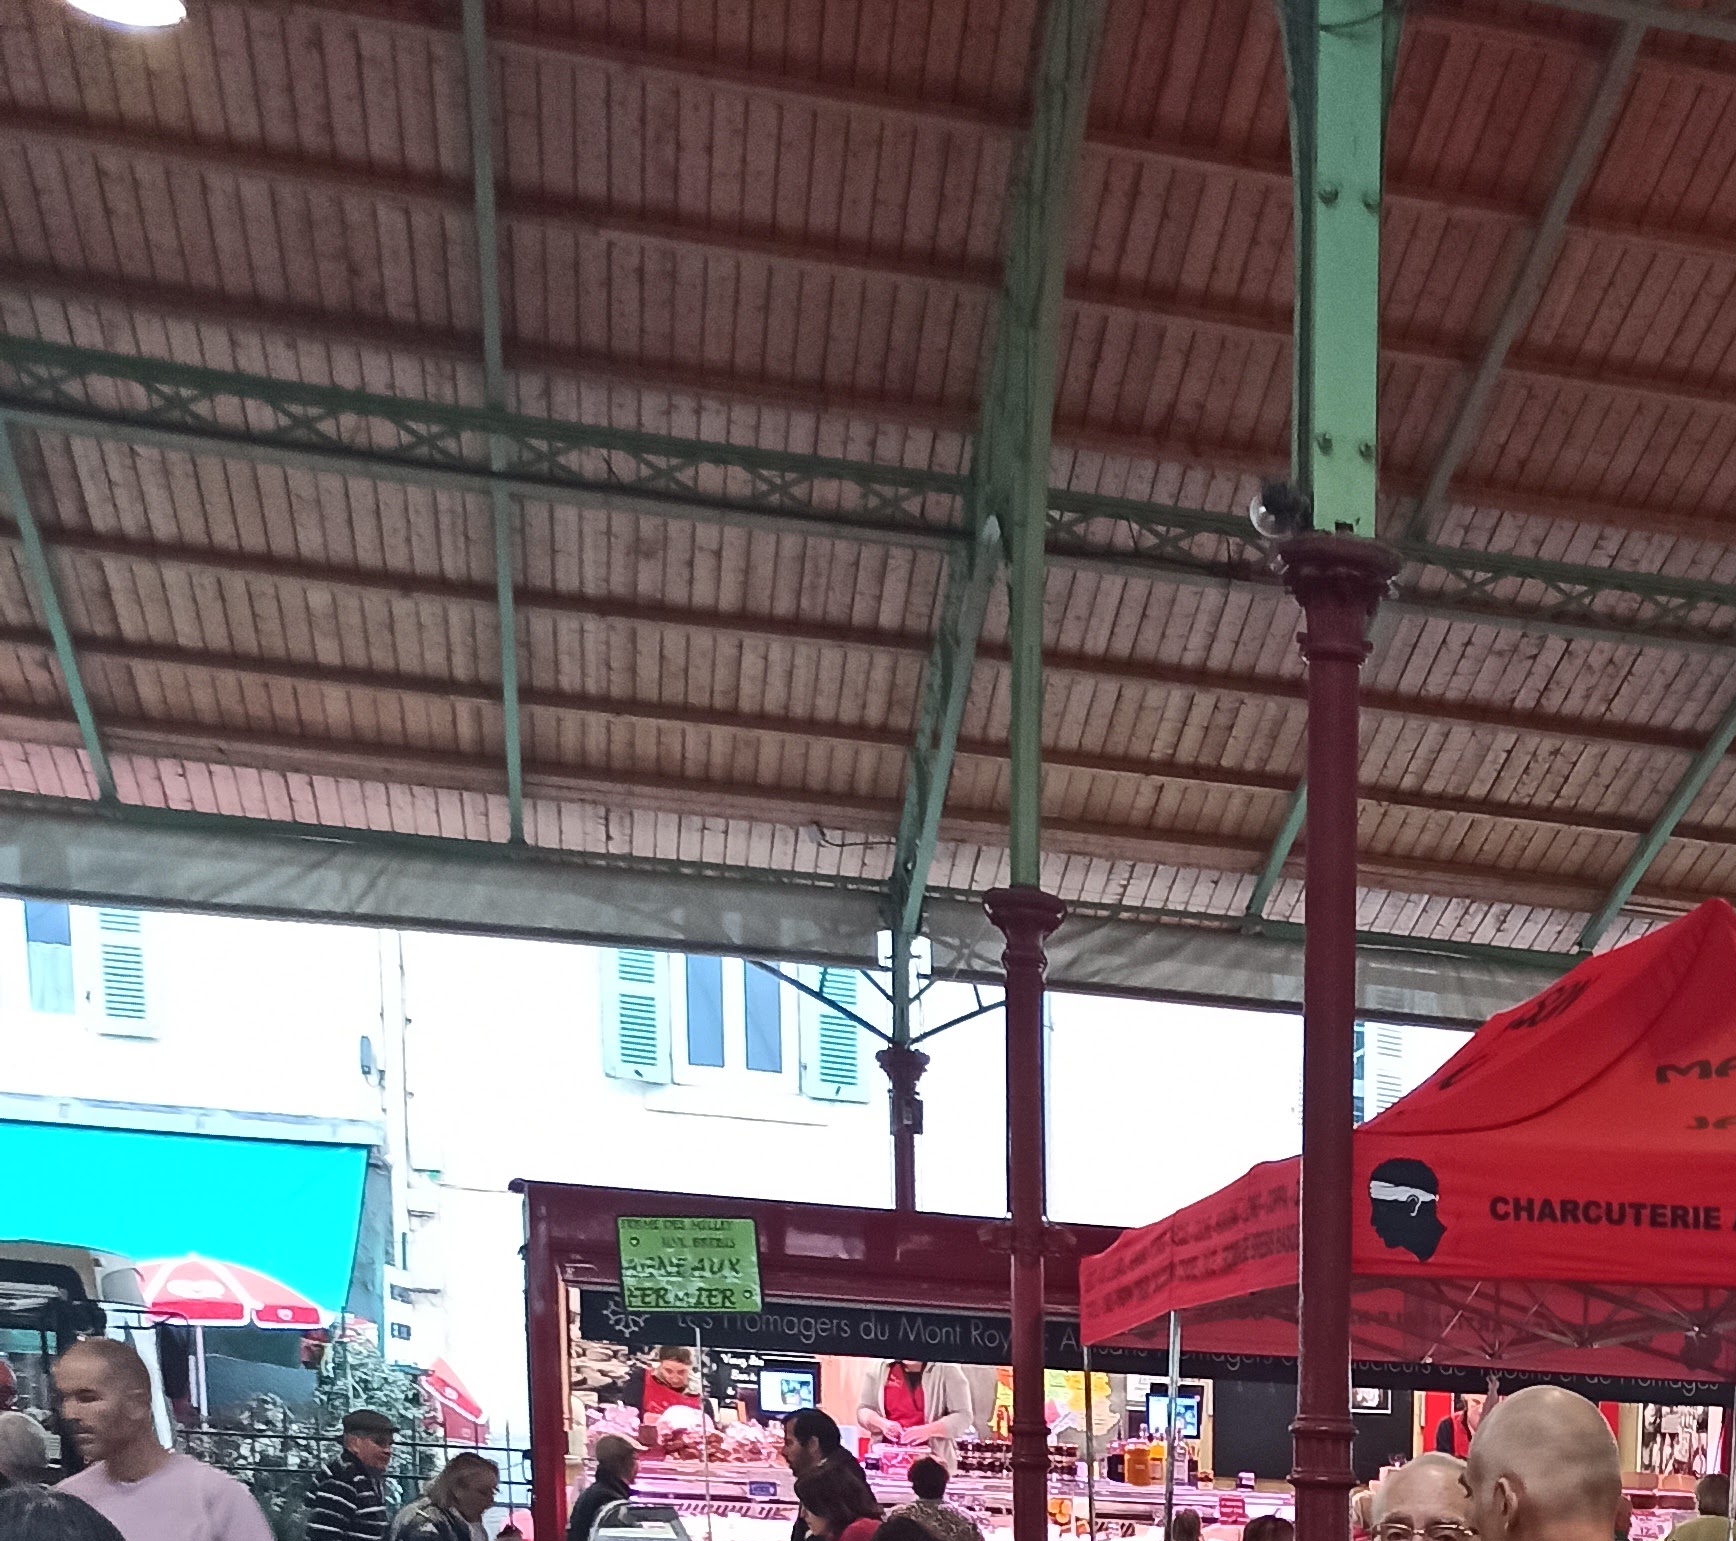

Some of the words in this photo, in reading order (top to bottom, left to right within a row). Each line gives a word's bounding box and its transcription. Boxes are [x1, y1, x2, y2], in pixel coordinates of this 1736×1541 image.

[1488, 1195, 1722, 1232] CHARCUTERIE
[860, 1311, 889, 1341] du
[898, 1315, 962, 1345] Mont
[970, 1318, 1012, 1356] Roy
